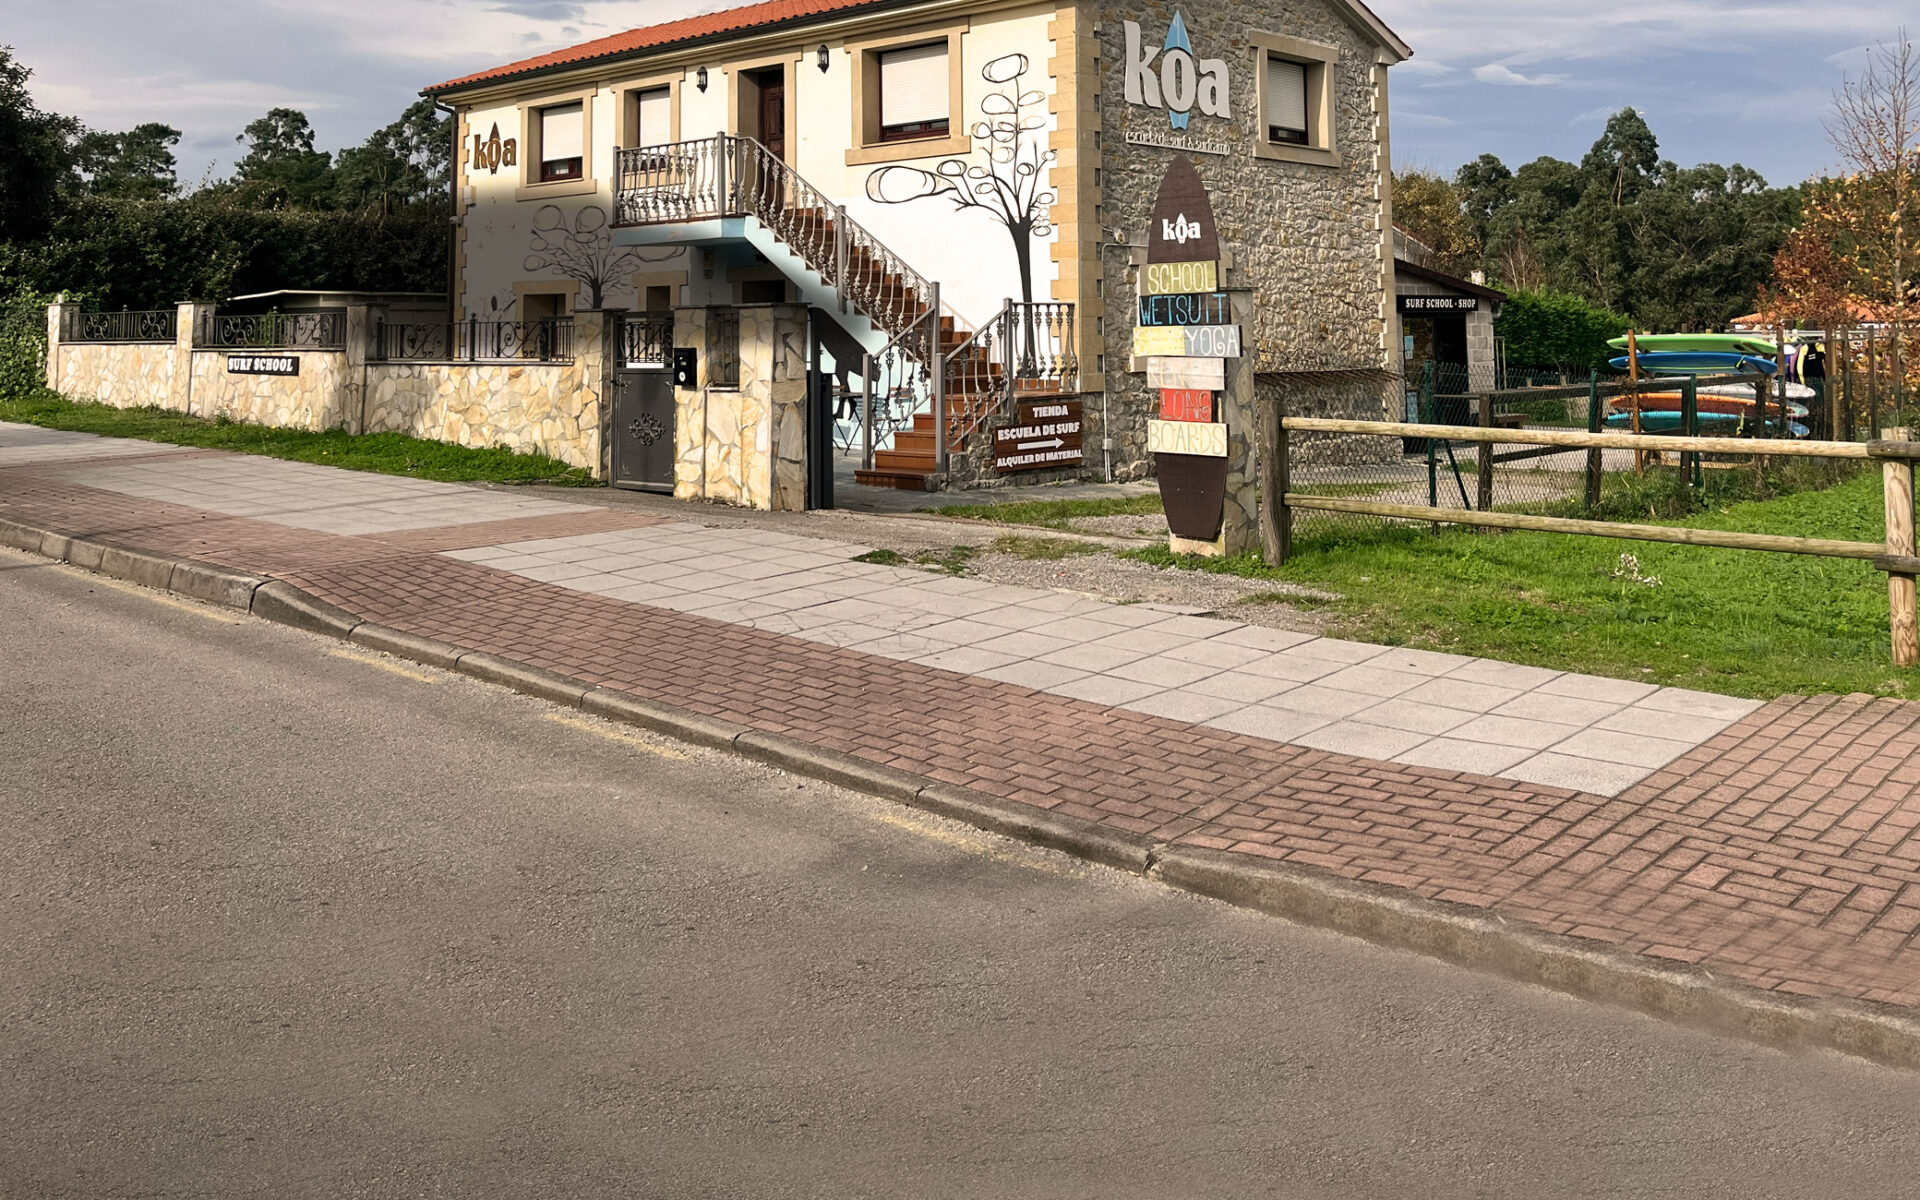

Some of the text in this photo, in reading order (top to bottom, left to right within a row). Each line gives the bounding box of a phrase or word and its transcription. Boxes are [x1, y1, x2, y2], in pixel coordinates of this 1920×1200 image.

[1123, 20, 1231, 119] koa
[473, 134, 516, 170] koa
[1162, 218, 1201, 241] koa
[1147, 263, 1216, 294] SCHOOL
[1140, 294, 1227, 325] WETSUIT
[1405, 298, 1425, 308] SURF
[1426, 298, 1453, 308] SCHOOL
[1458, 298, 1476, 308] SHOP
[1184, 327, 1239, 356] YOGA
[228, 358, 293, 371] SURF SCHOOL
[1032, 405, 1069, 418] TIENDA
[1162, 391, 1211, 420] LONG
[997, 422, 1080, 441] ESCUELA DE SURF
[1149, 422, 1225, 455] BOARDS
[997, 449, 1082, 467] ALQUILER DE MATERIAL
